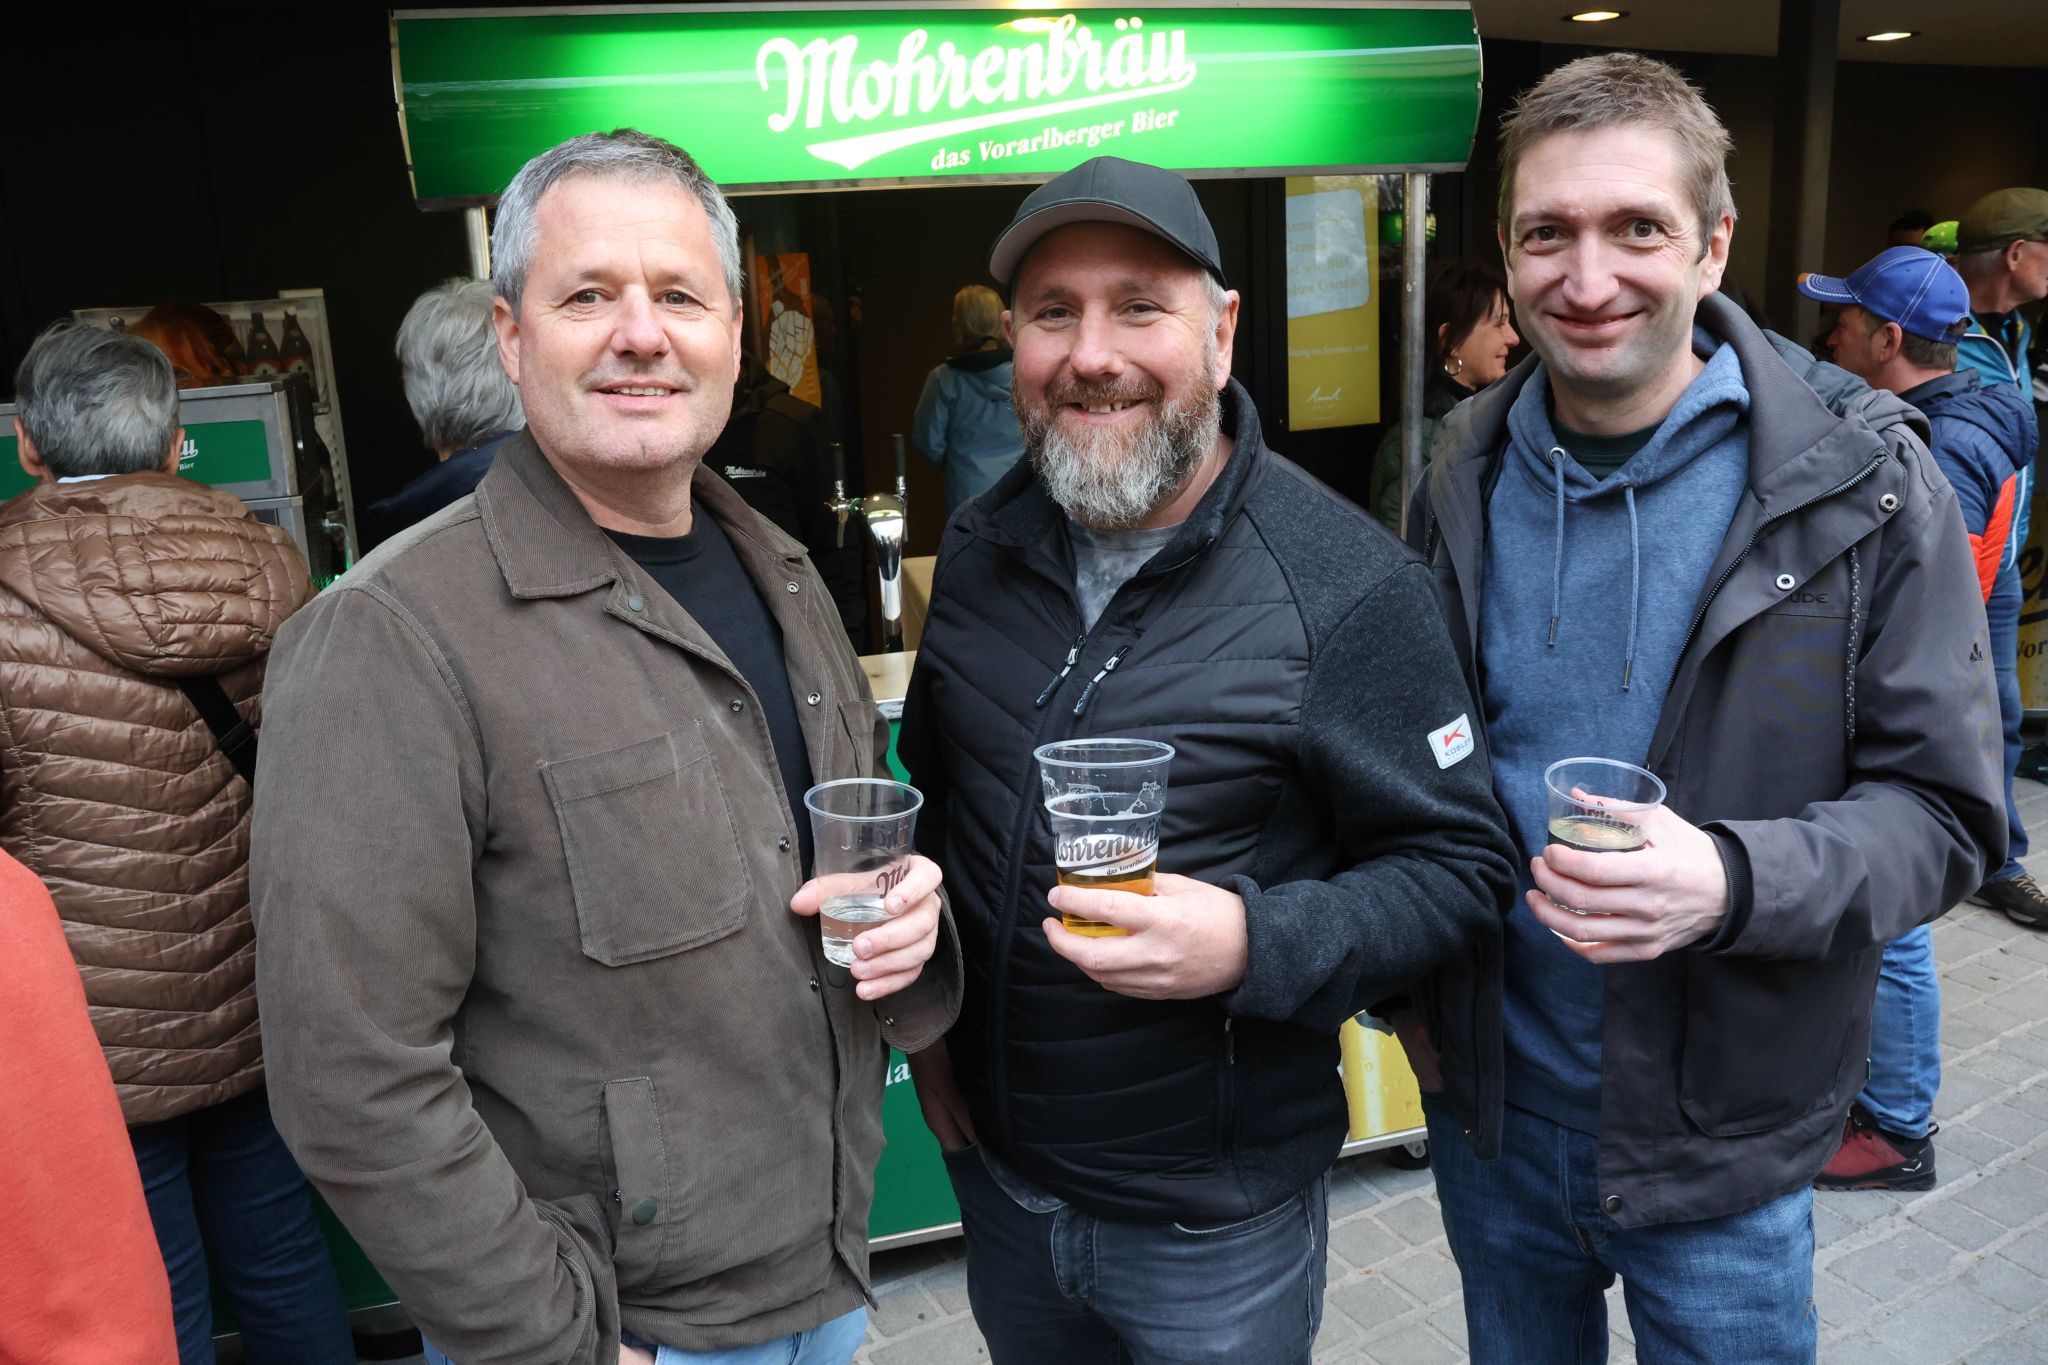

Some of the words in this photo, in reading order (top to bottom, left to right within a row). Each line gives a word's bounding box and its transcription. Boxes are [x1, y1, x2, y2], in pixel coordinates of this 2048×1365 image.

[756, 13, 1197, 133] Mohrenbräu
[930, 147, 971, 171] das
[978, 118, 1126, 162] Vorarlberger
[1130, 108, 1180, 135] Bier
